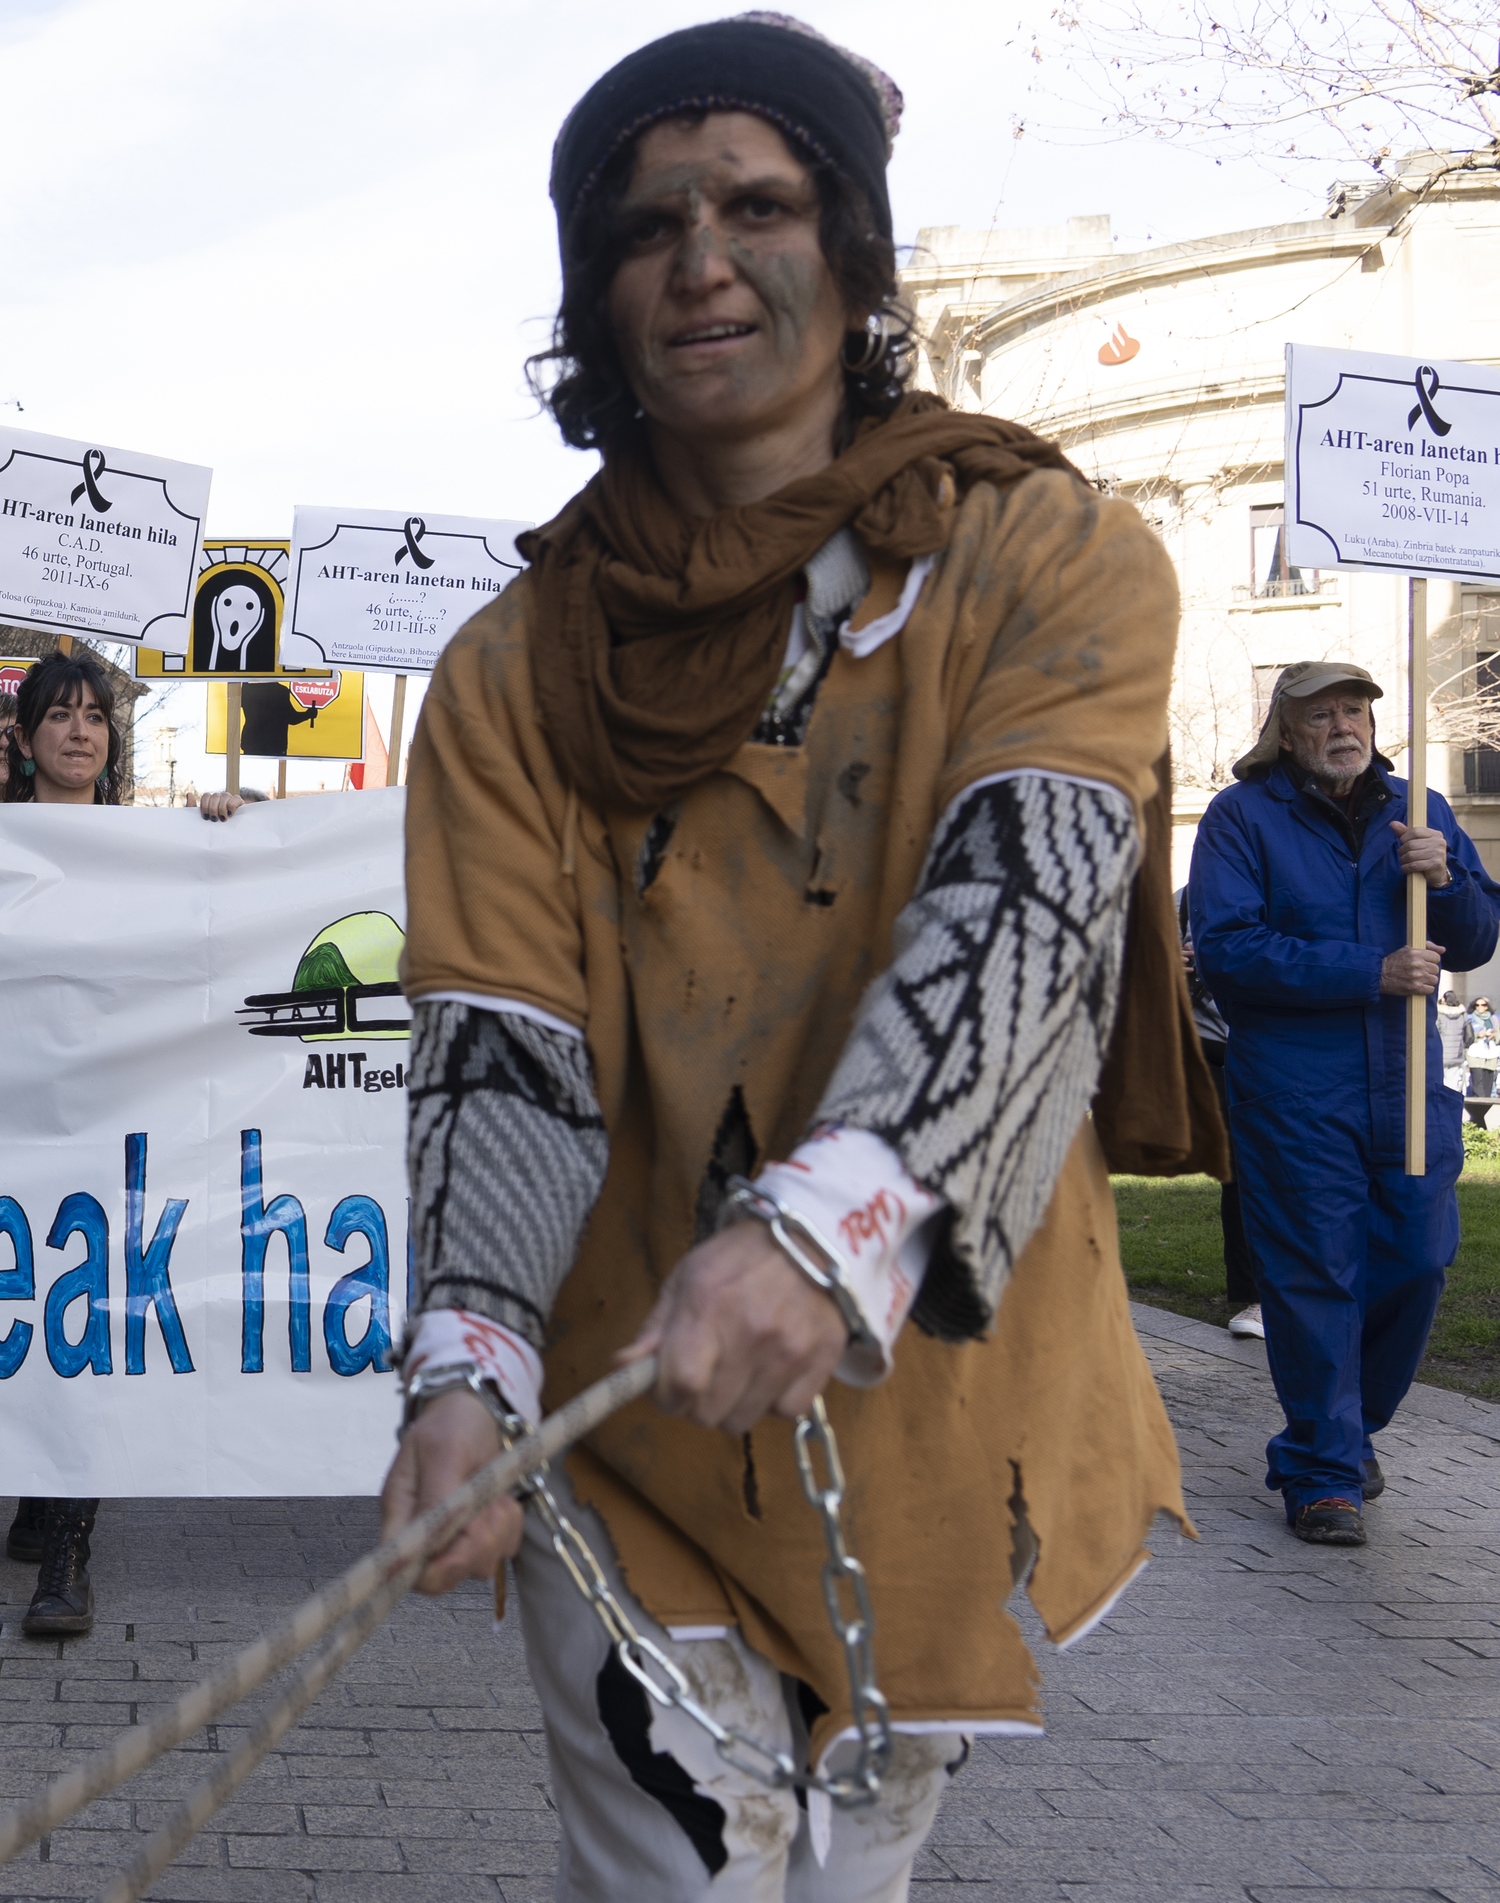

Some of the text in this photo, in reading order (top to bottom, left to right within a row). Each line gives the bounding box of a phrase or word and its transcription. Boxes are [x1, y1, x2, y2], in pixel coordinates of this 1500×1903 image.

[1319, 428, 1413, 455] AHT-aren
[1420, 439, 1487, 463] lanetan
[1381, 461, 1469, 488] Florian Popa
[1362, 481, 1486, 508] 51 urte, Rumania.
[1381, 503, 1468, 526] 2008-VII-14
[79, 514, 141, 539] lanetan
[147, 526, 177, 546] hila
[58, 533, 103, 553] C.A.D.
[1344, 533, 1365, 545] Luku
[1403, 539, 1433, 551] Zinbria
[1435, 542, 1456, 553] batek
[21, 546, 132, 578] 46 urte, Portugal.
[1363, 547, 1413, 561] Mecanotubo
[41, 567, 109, 590] 2011-IX-6
[317, 565, 501, 593] AHT-aren lanetan hila
[56, 610, 86, 623] Enpresa
[69, 602, 101, 615] Kamioia
[365, 603, 381, 615] 46
[385, 607, 412, 618] urte,
[372, 619, 436, 634] 2011-III-8
[331, 641, 363, 651] Antzuola
[409, 647, 443, 657] Bihotzek
[331, 650, 347, 658] bere
[348, 651, 376, 660] kamioia
[416, 656, 440, 667] Enpre
[295, 685, 334, 697] ESKLABUTZA
[303, 1052, 409, 1093] AHTgel
[238, 1128, 410, 1378] ha
